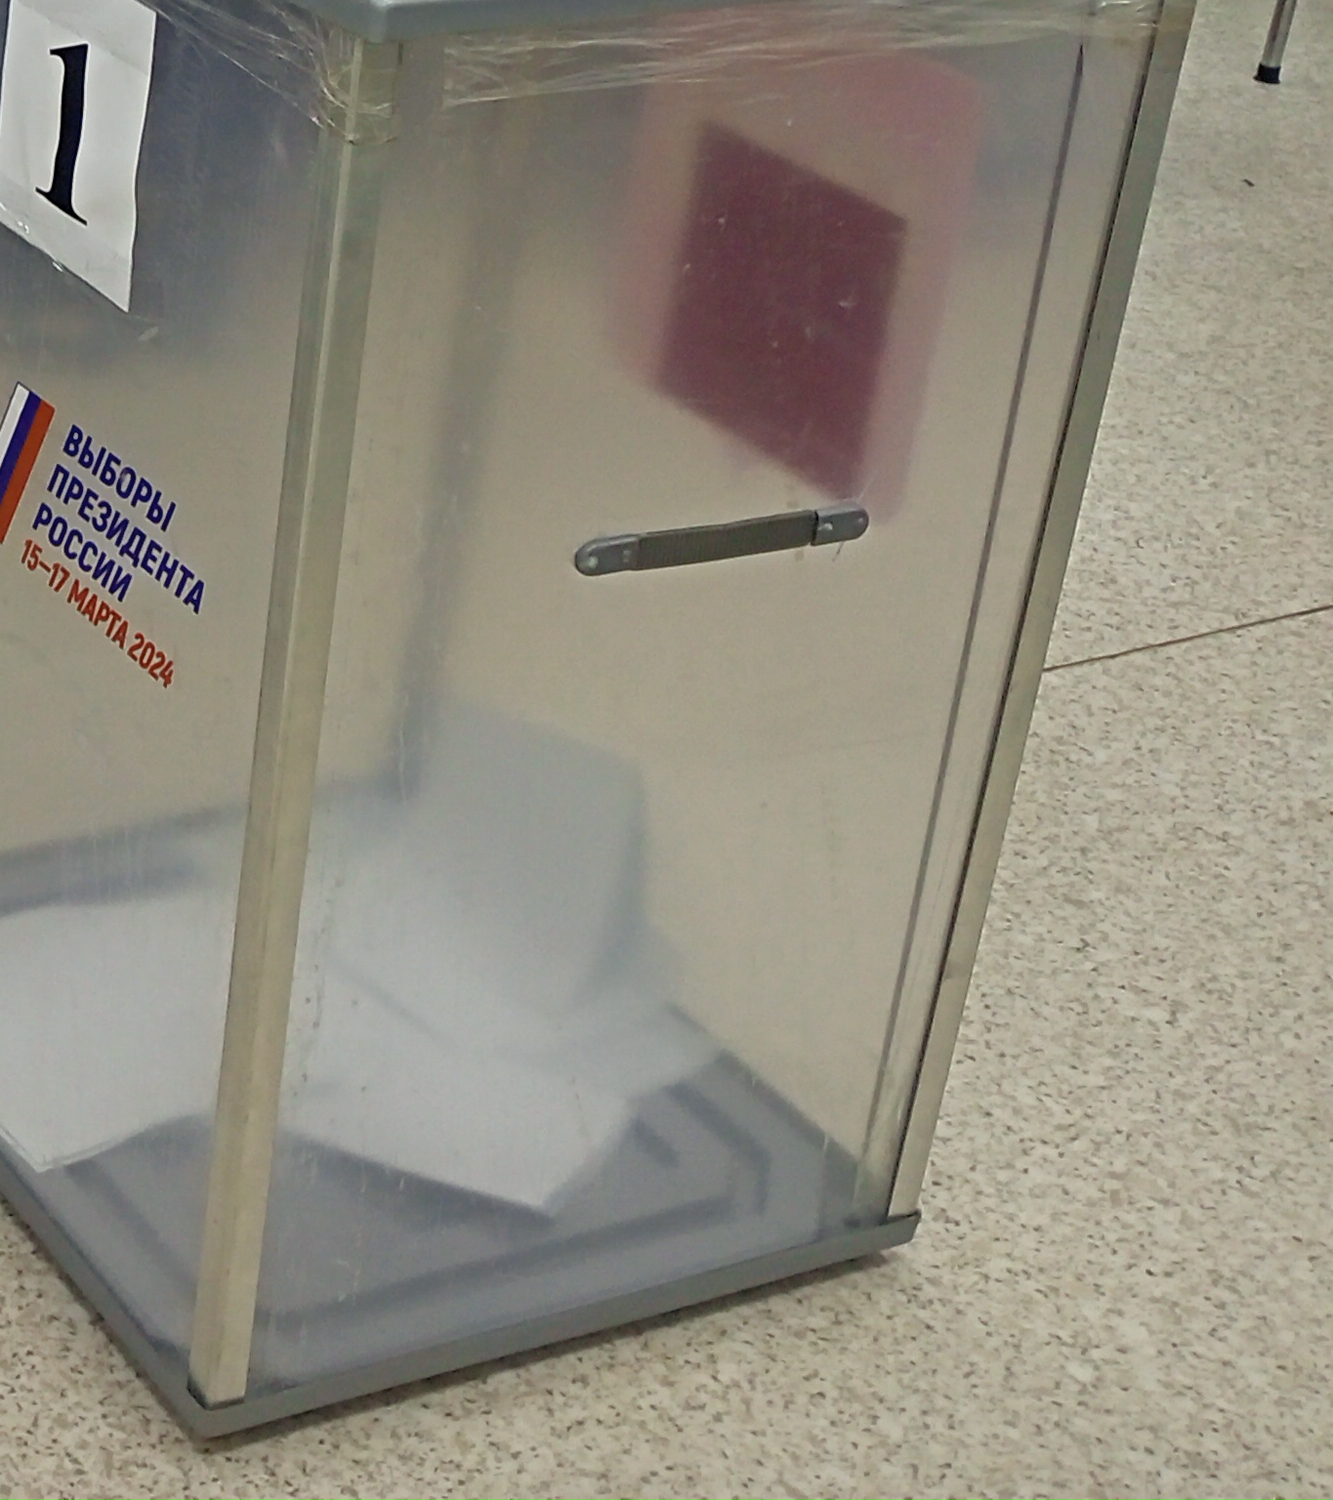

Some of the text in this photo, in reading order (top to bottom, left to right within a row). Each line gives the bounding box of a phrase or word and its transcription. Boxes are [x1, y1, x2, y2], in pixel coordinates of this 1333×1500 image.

[35, 43, 89, 226] 1
[32, 502, 132, 602] РОССИИ
[47, 463, 205, 615] ПРЕЗИДЕНТА
[62, 424, 176, 532] ВЫБОРЫ
[20, 539, 174, 689] 15–17 МАРТА 2024
